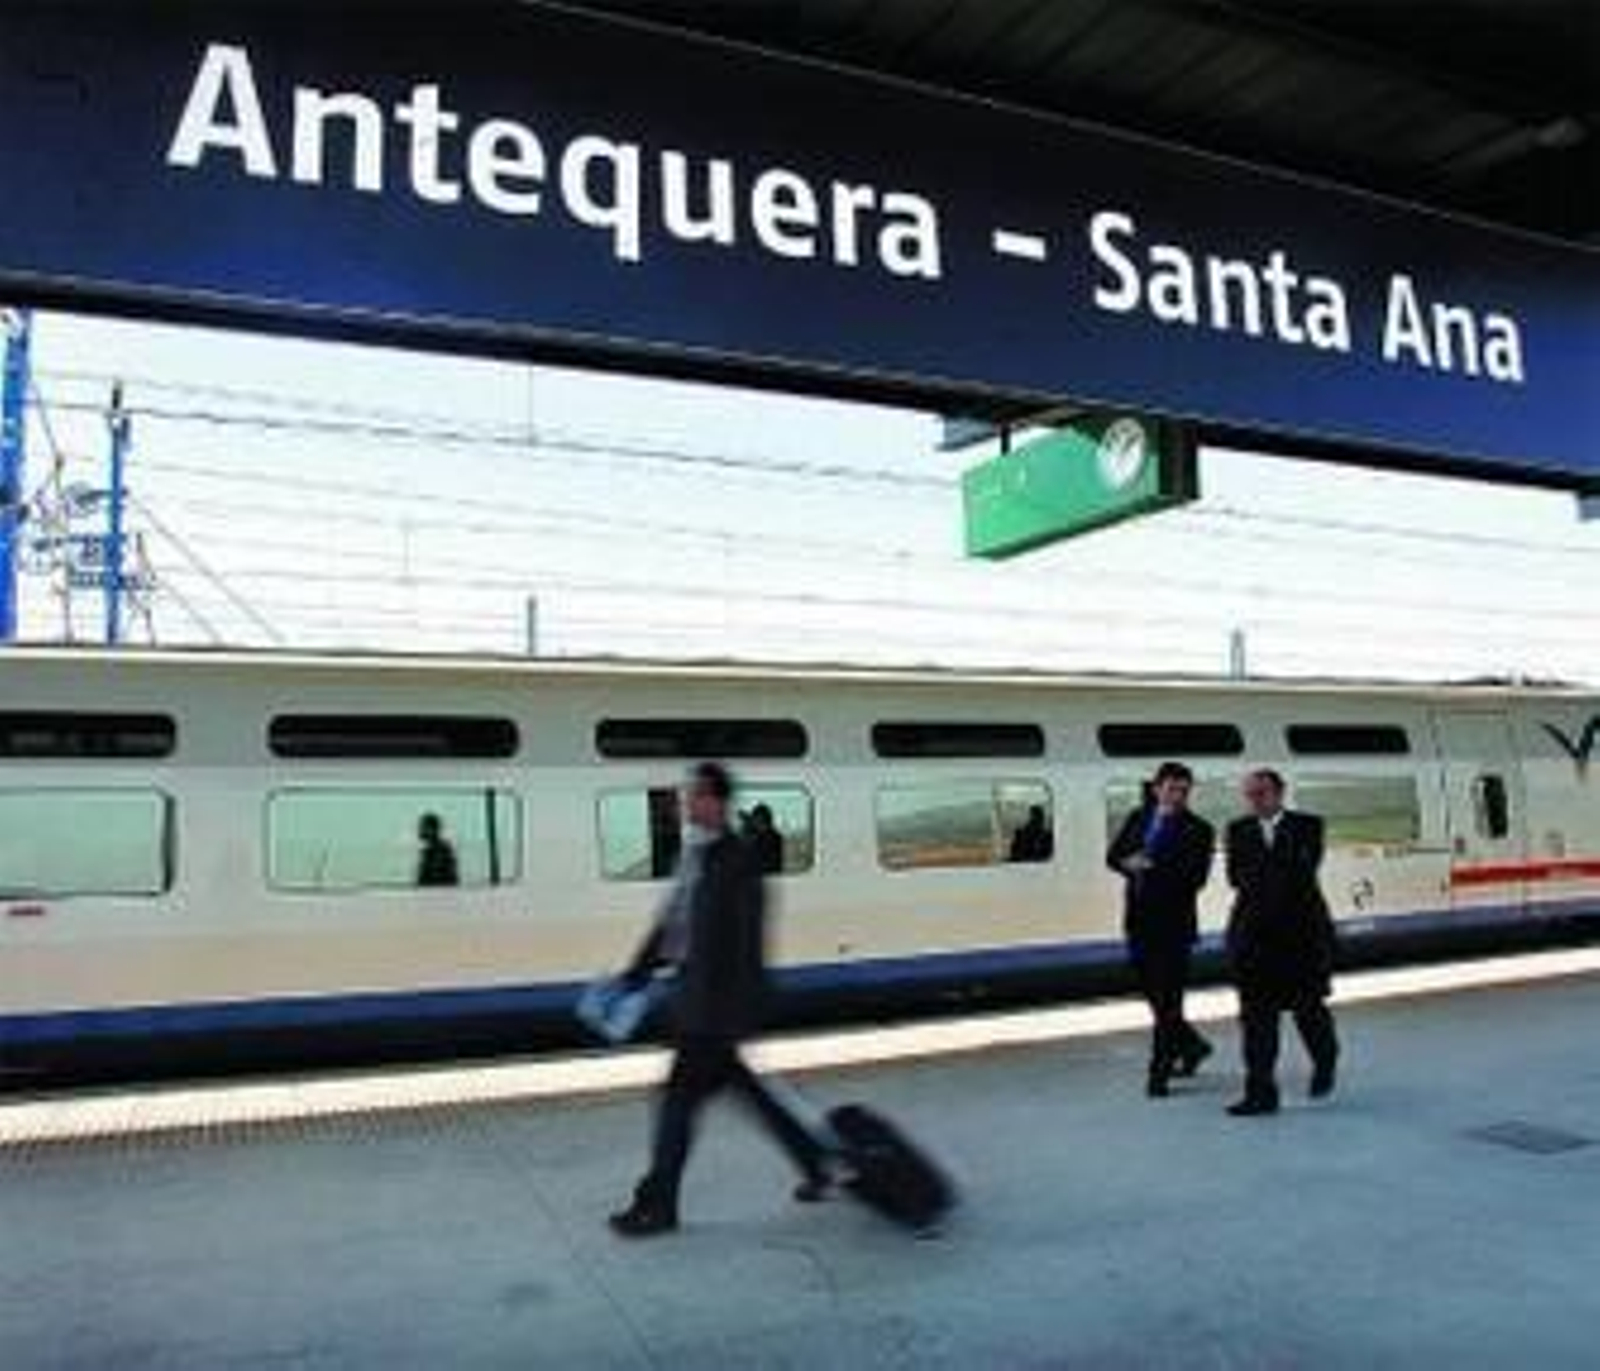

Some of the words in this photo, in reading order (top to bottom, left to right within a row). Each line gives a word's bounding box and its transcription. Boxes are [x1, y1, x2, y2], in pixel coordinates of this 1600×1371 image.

[166, 43, 942, 279] Antequera
[1089, 211, 1351, 353] Santa
[1382, 275, 1525, 383] Ana
